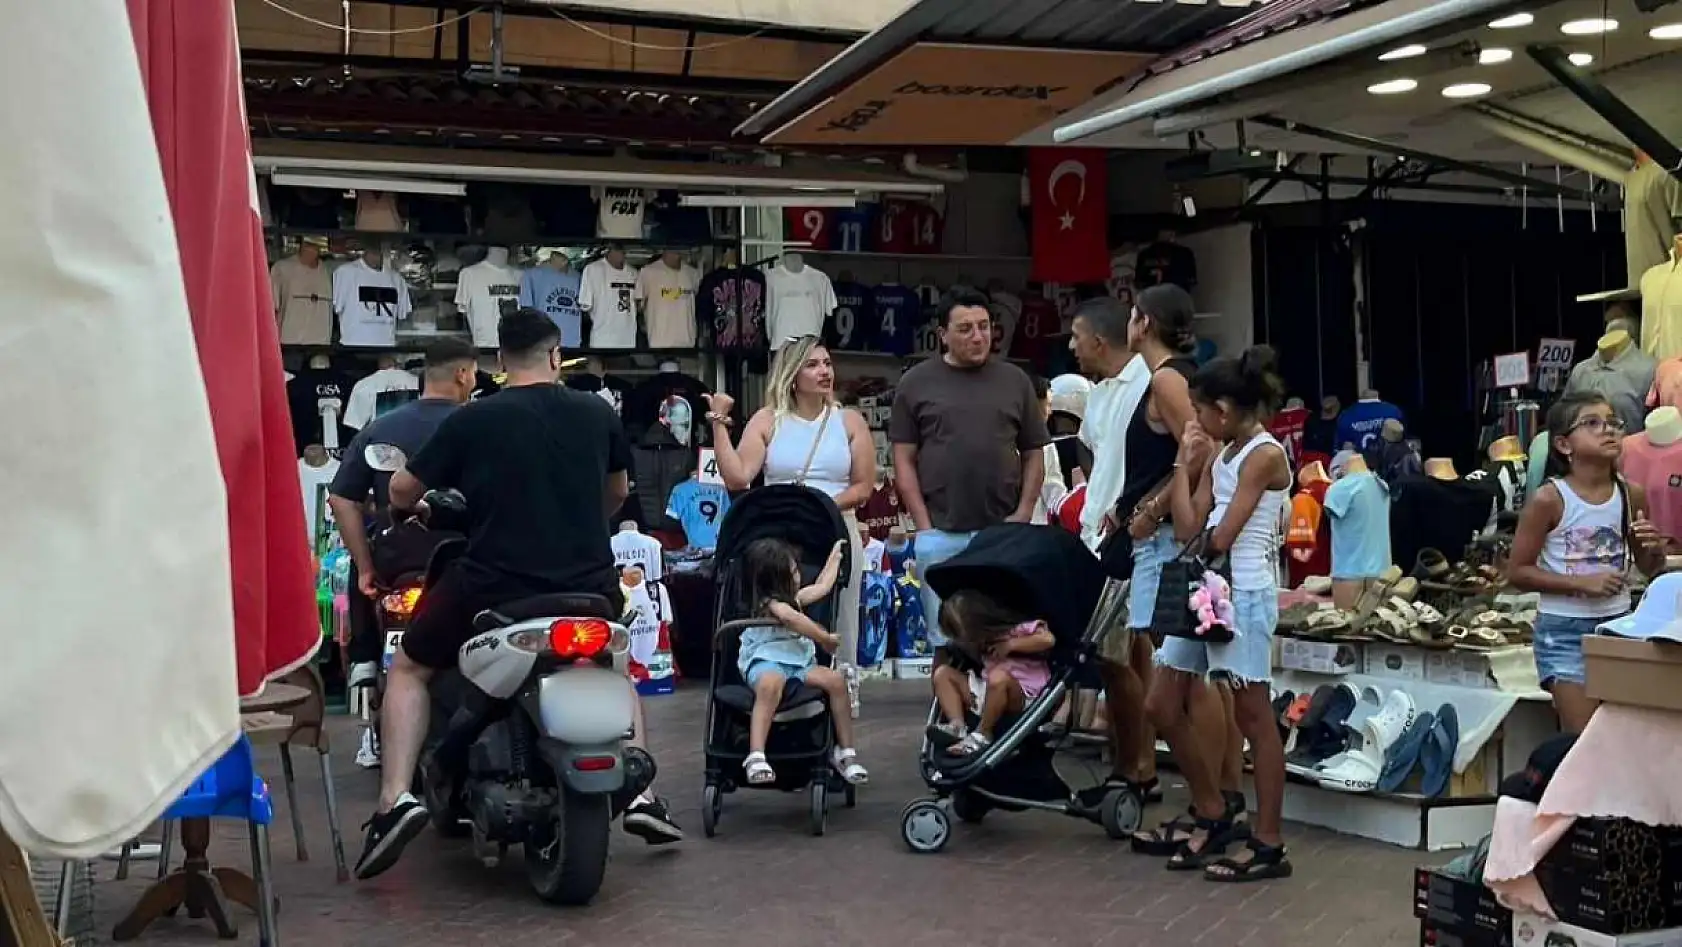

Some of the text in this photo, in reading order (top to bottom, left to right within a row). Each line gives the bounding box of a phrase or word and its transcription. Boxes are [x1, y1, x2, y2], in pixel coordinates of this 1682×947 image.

[611, 201, 638, 215] FOX
[803, 210, 824, 240] 9
[839, 222, 862, 251] 11
[912, 213, 935, 245] 14
[836, 307, 854, 348] 9
[881, 307, 897, 337] 4
[1025, 313, 1038, 338] 8
[917, 330, 936, 351] 10
[1541, 345, 1570, 363] 200
[698, 500, 717, 525] 9
